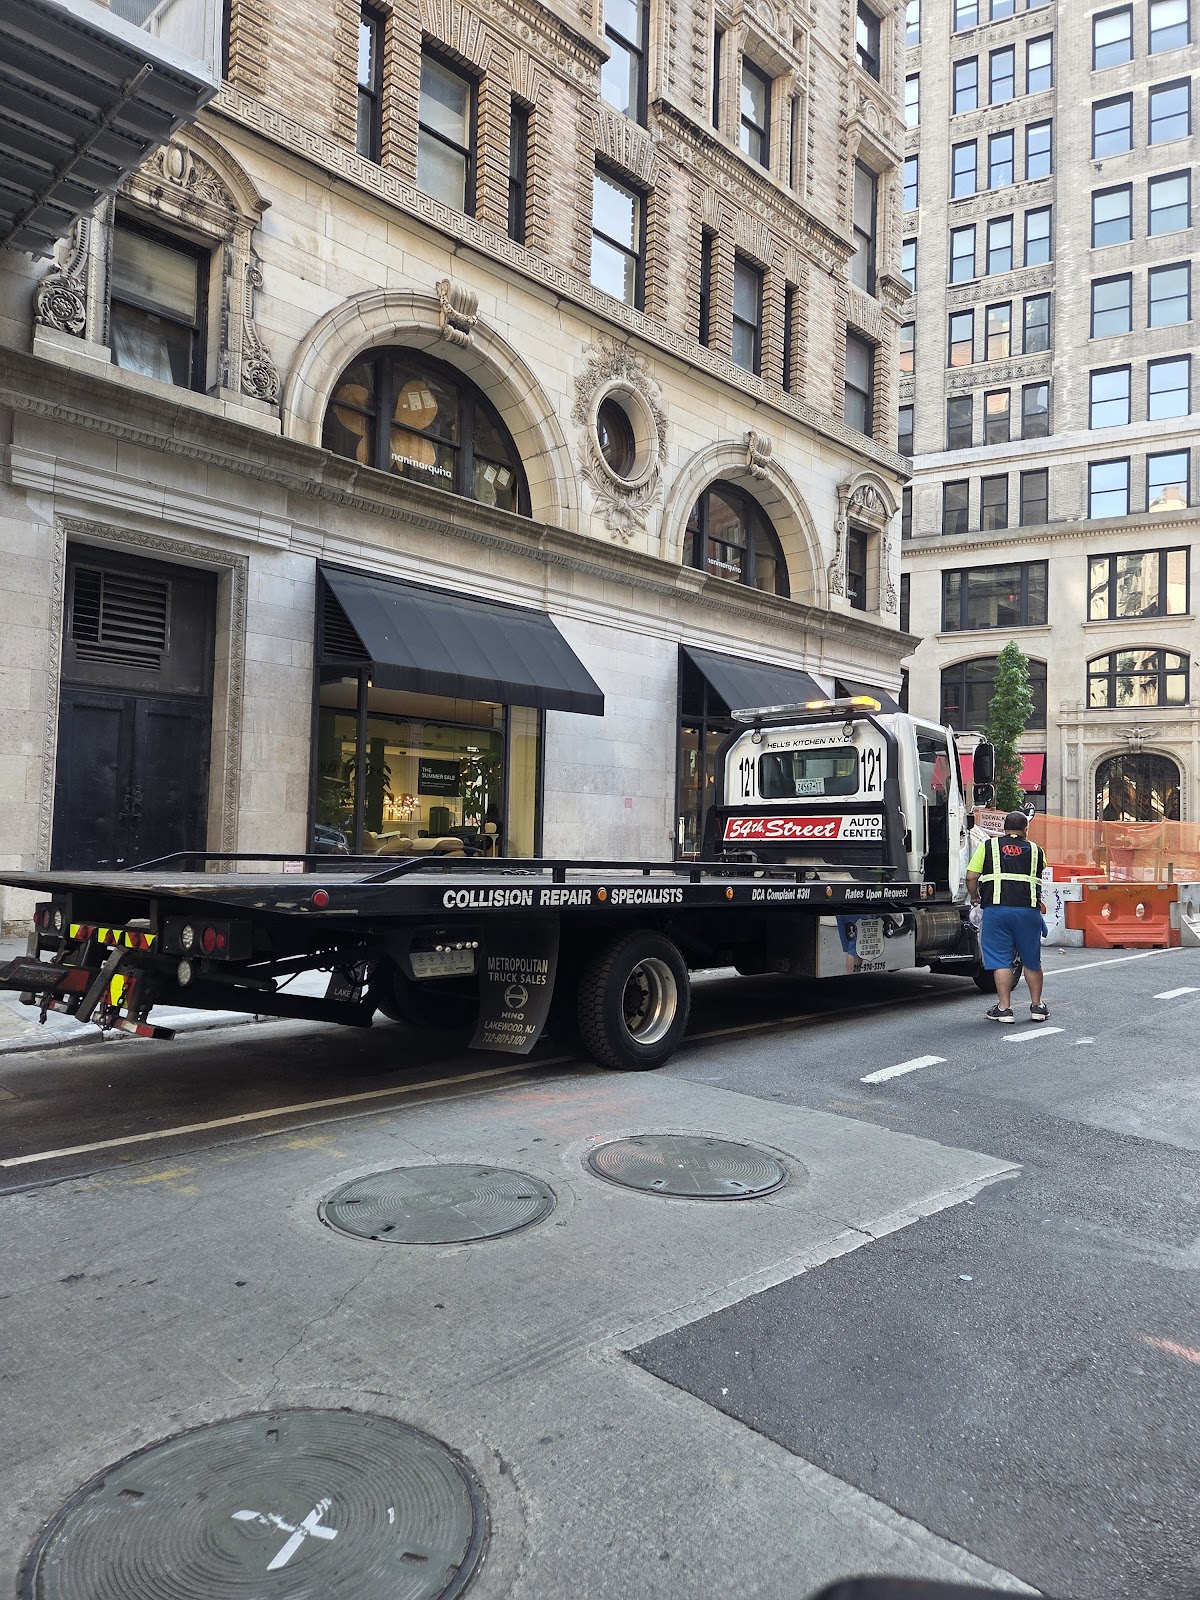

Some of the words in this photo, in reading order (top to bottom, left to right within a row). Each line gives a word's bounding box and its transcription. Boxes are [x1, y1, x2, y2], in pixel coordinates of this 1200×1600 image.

[391, 452, 452, 477] nanimarquina
[767, 741, 791, 749] HELL'S
[792, 738, 826, 747] KITCHEN
[861, 747, 882, 792] 121
[739, 757, 755, 797] 121
[765, 820, 836, 837] Street
[849, 818, 880, 827] AUTO
[983, 820, 1002, 828] CLOSED
[842, 828, 883, 838] CENTER
[1003, 845, 1021, 855] AAA
[443, 889, 533, 909] COLLISION
[539, 889, 591, 906] REPAIR
[610, 887, 684, 905] SPECIALISTS
[751, 888, 765, 901] DCA
[766, 888, 795, 900] Complaint
[844, 888, 864, 900] Rates
[865, 889, 882, 901] Upon
[883, 887, 909, 900] Request
[487, 956, 549, 974] METROPOLITAN
[488, 971, 518, 983] TRUCK
[520, 973, 547, 985] SALES
[501, 1011, 525, 1020] HINO
[524, 1024, 536, 1034] NJ
